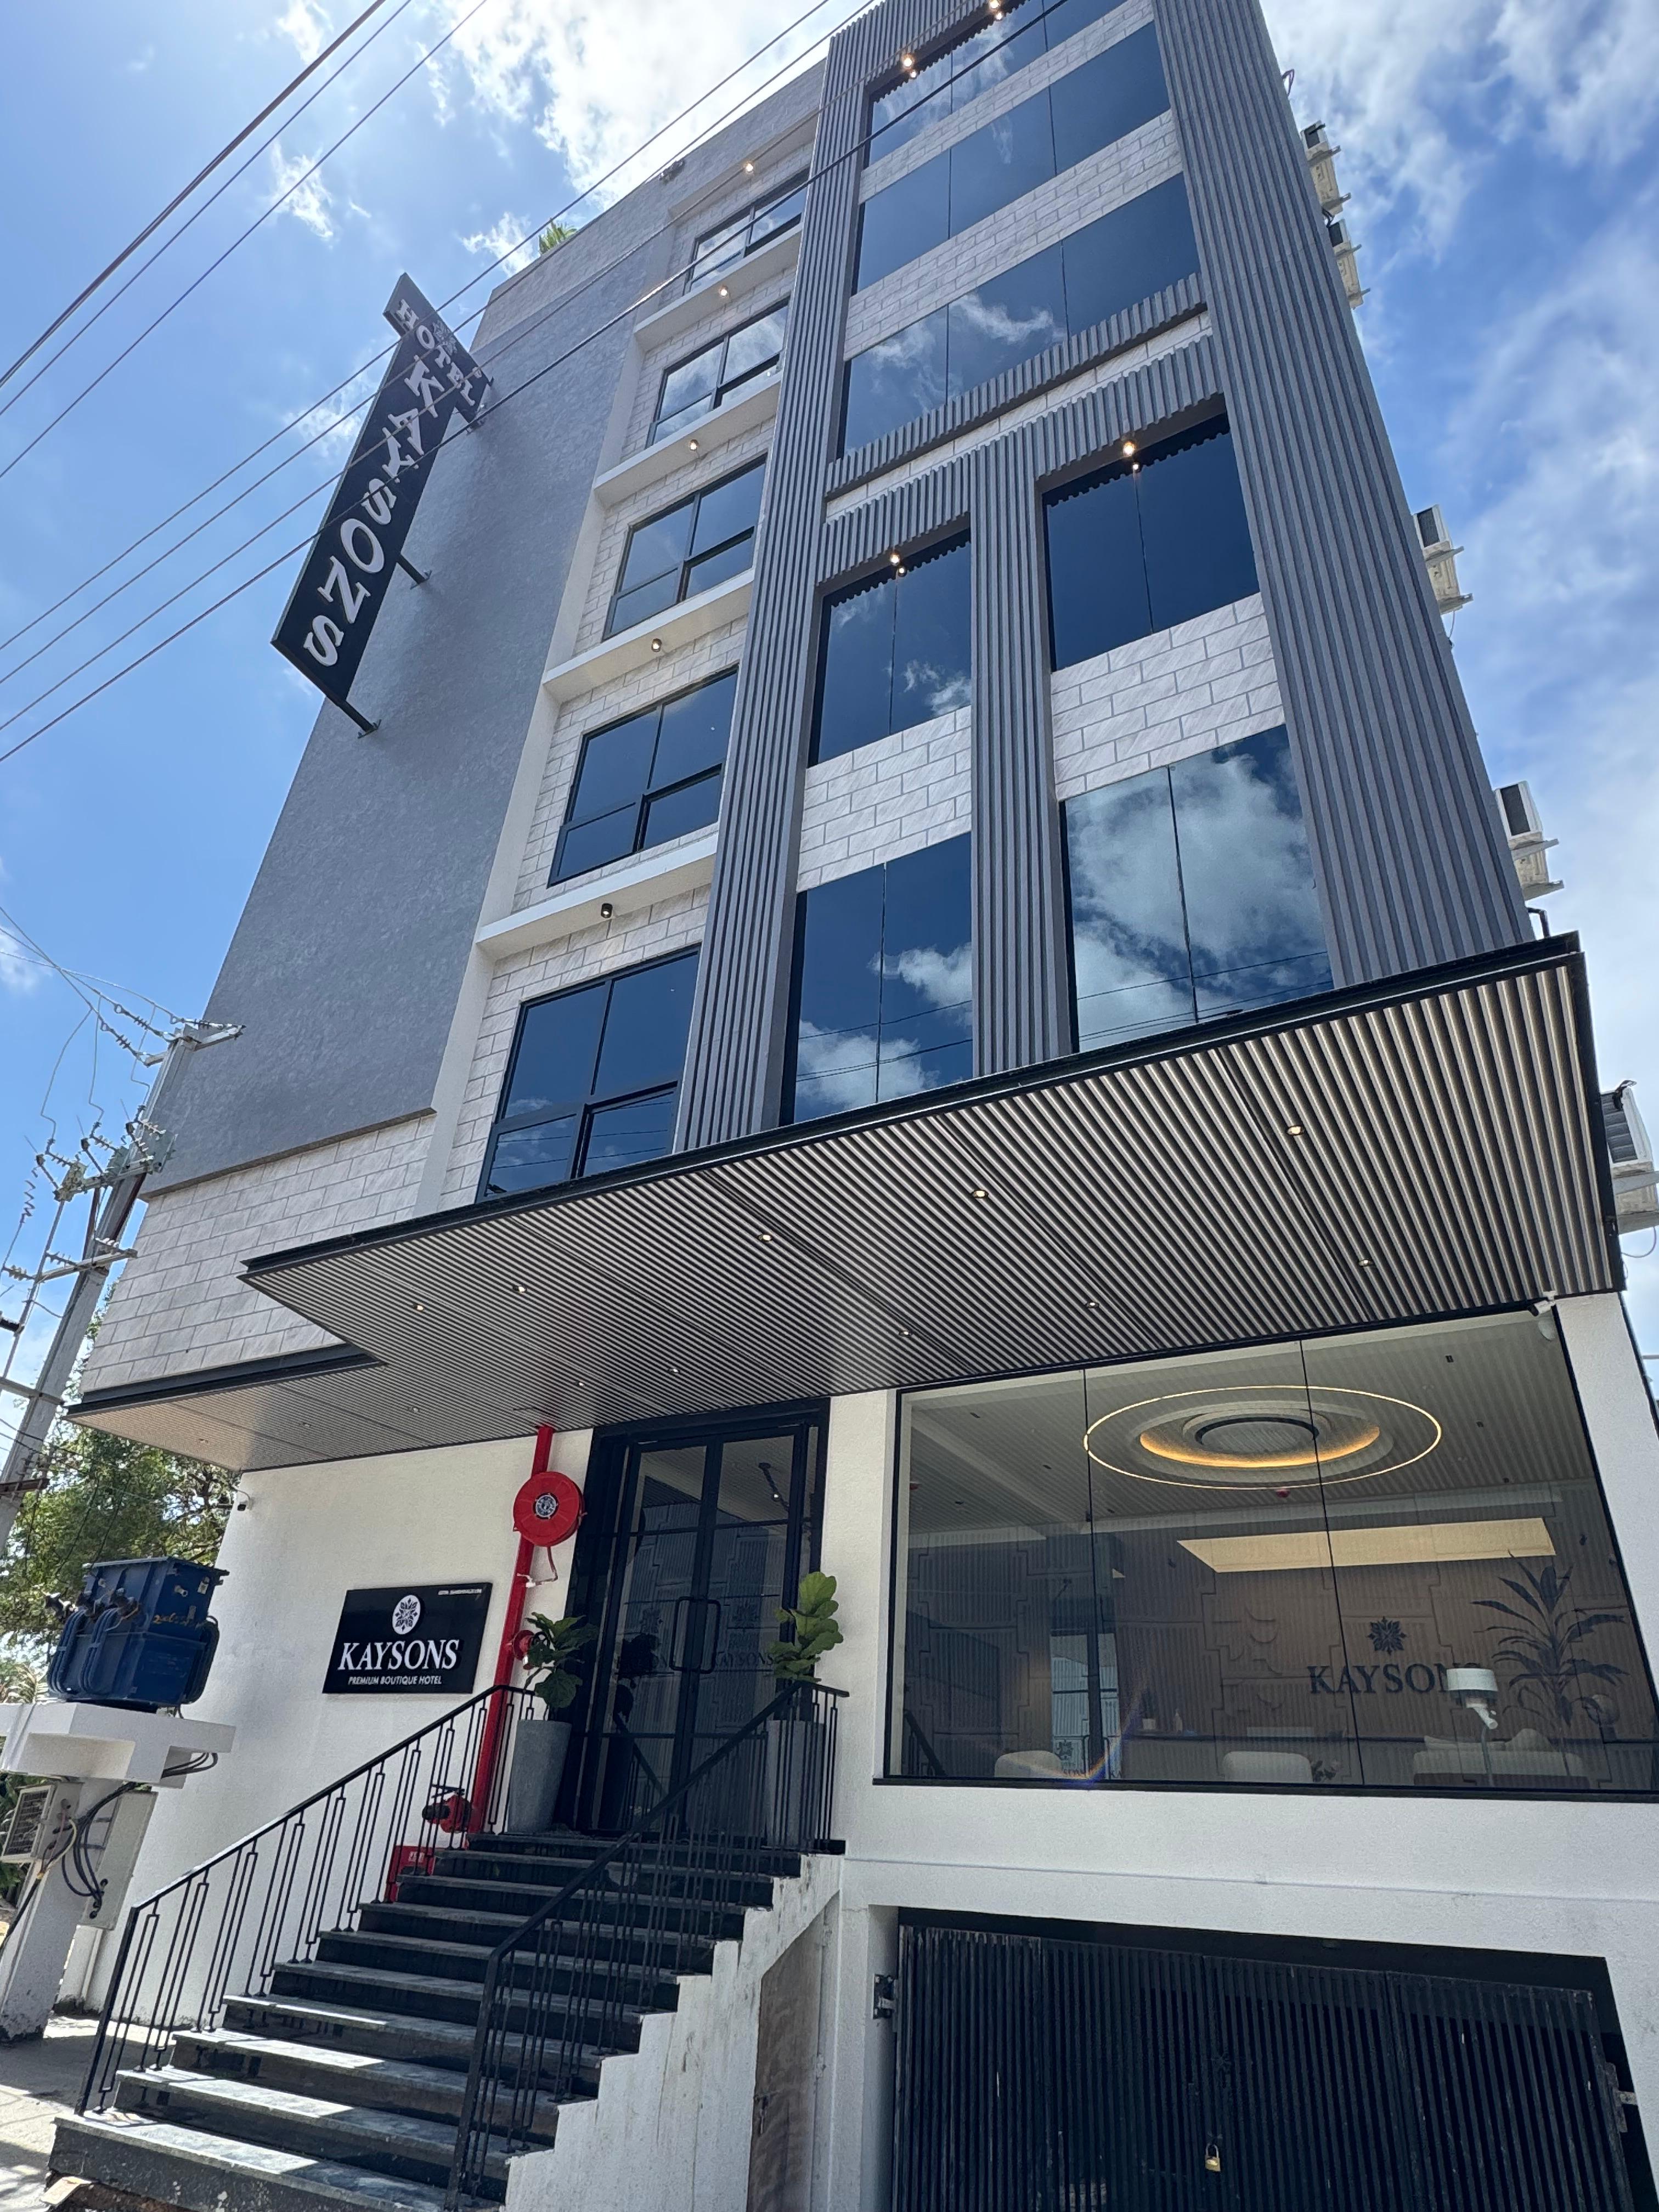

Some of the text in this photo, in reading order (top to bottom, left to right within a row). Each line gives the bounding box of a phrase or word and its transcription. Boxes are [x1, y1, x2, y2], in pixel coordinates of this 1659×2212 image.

[396, 298, 476, 407] HOTEL
[303, 354, 444, 667] KAYSONS
[337, 1639, 460, 1671] KAYSONS
[348, 1675, 442, 1685] PREMIUM BOUTIQUE HOTEL
[1307, 1662, 1480, 1694] KAYSON
